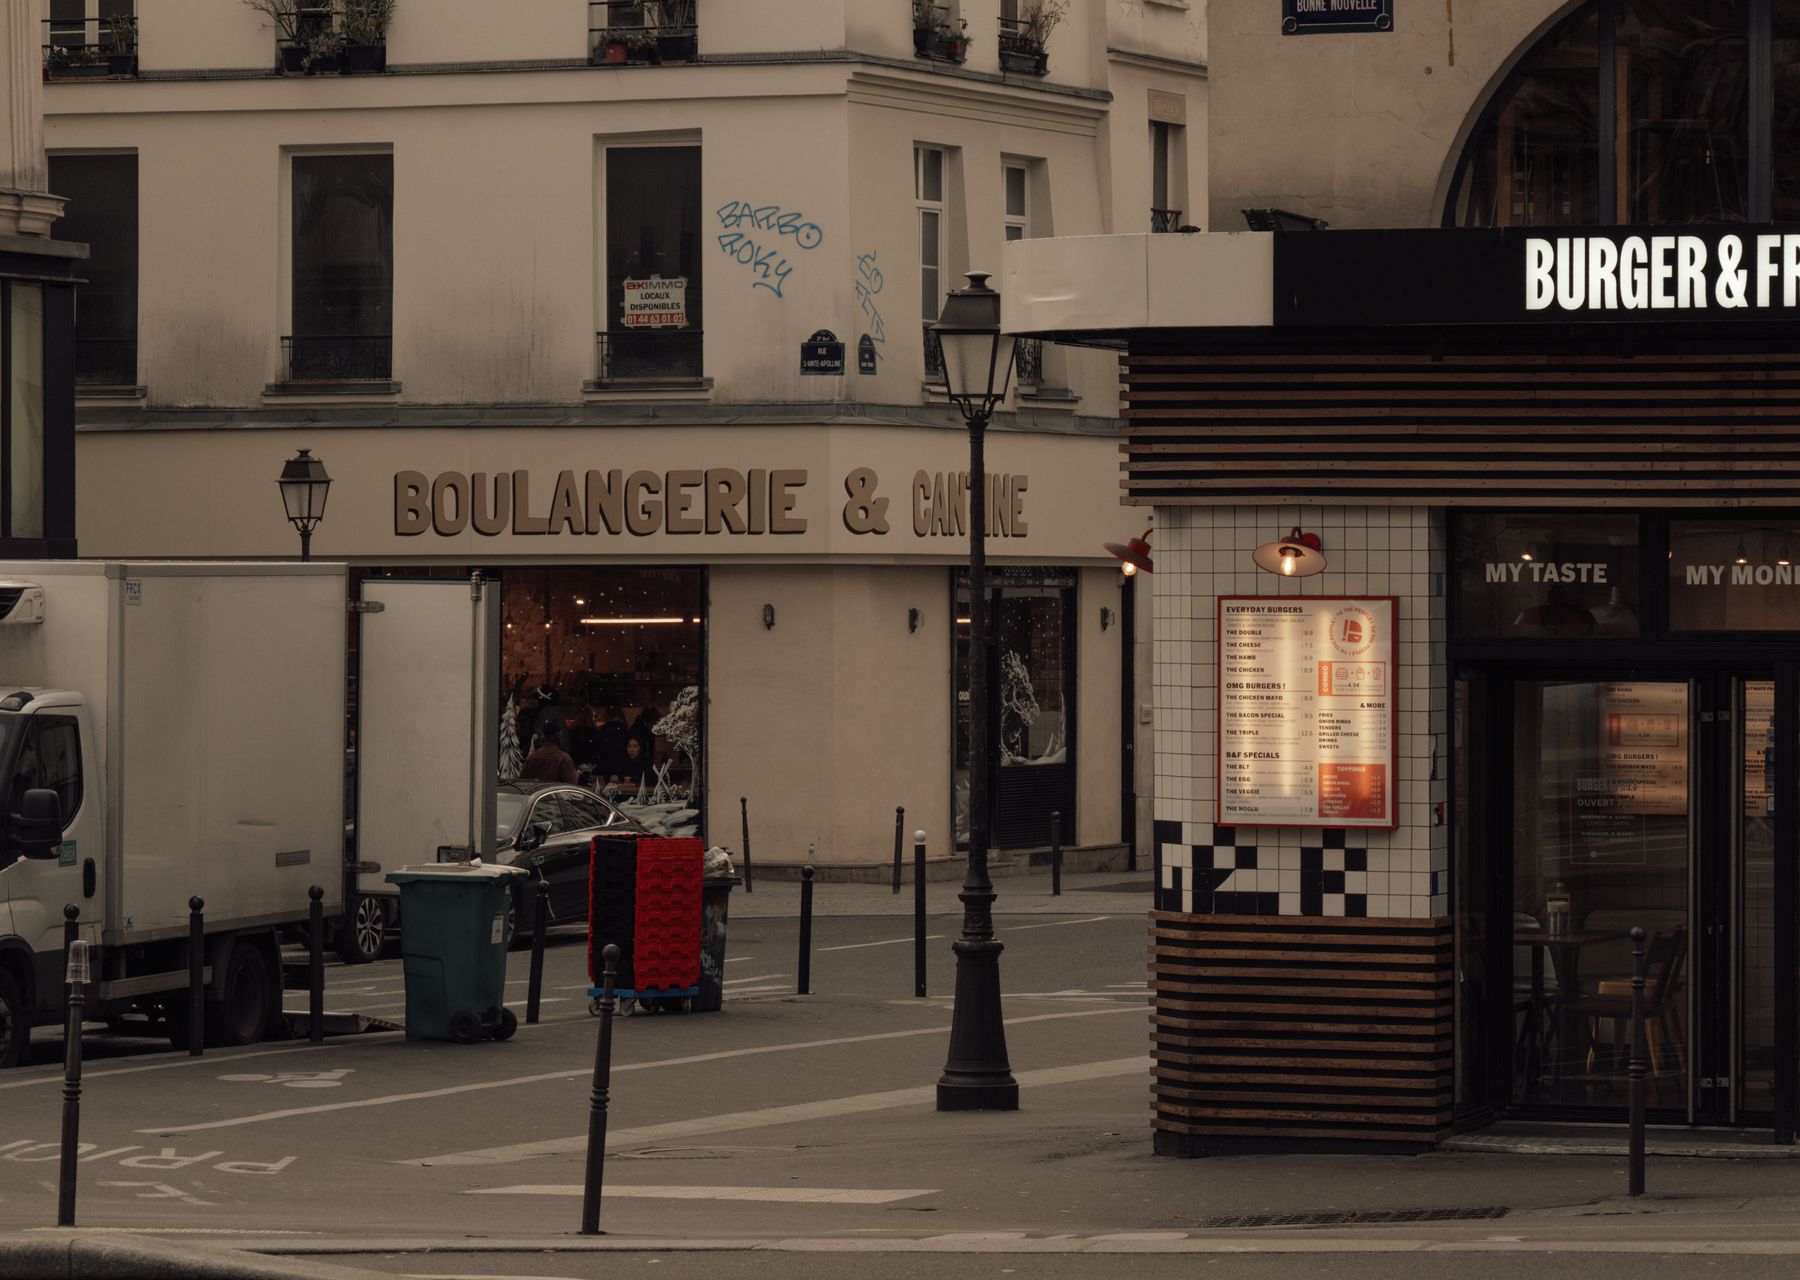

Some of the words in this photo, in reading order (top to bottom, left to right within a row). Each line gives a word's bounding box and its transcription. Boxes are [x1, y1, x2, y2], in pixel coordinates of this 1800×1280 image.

[1525, 235, 1708, 311] BURGER
[1715, 234, 1749, 309] &
[640, 292, 670, 300] LOCAUX
[630, 302, 681, 311] DISPONIBLES
[627, 315, 637, 324] 01
[638, 315, 649, 323] 44
[650, 314, 660, 323] 63
[661, 314, 671, 323] 01
[673, 314, 683, 322] 02
[394, 468, 809, 536] BOULANGERIE
[843, 466, 890, 535] &
[912, 469, 1029, 537] CANINE
[1486, 563, 1523, 583] MY
[1529, 563, 1608, 584] TASTE
[1686, 565, 1725, 585] MY
[1577, 799, 1614, 807] OUVERT
